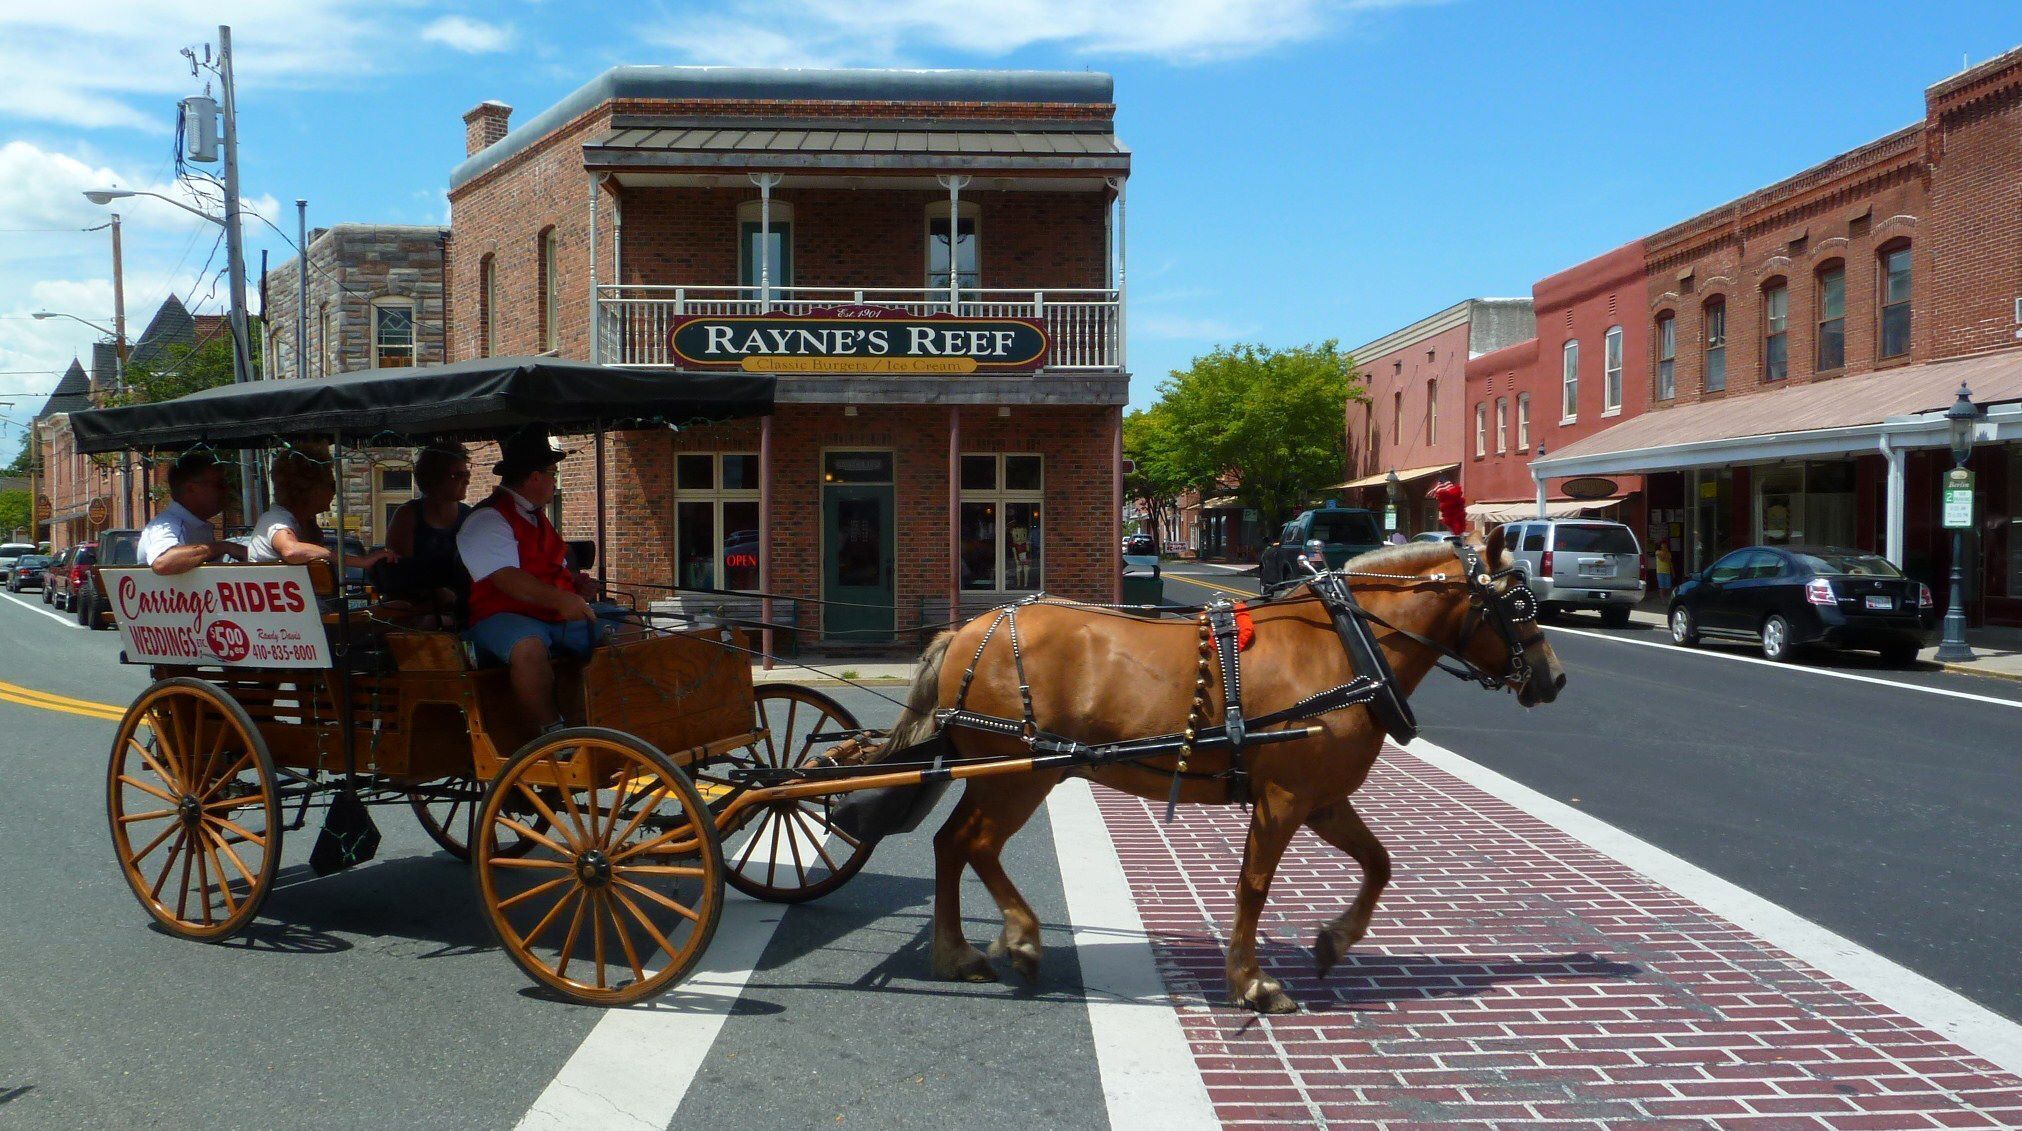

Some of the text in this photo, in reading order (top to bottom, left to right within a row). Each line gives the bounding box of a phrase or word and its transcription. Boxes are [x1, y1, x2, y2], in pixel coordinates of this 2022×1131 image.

[857, 308, 882, 318] 1901
[703, 326, 1015, 355] RAYNE'S REEF
[757, 359, 806, 371] Classic
[813, 359, 868, 373] Burgers
[887, 360, 907, 371] Ice
[913, 359, 963, 371] Cream
[1946, 492, 1953, 502] 2
[726, 554, 757, 567] OPEN
[119, 575, 305, 632] Carriage RIDES
[129, 625, 198, 657] WEDDINGS
[252, 644, 318, 661] 410-835-8001
